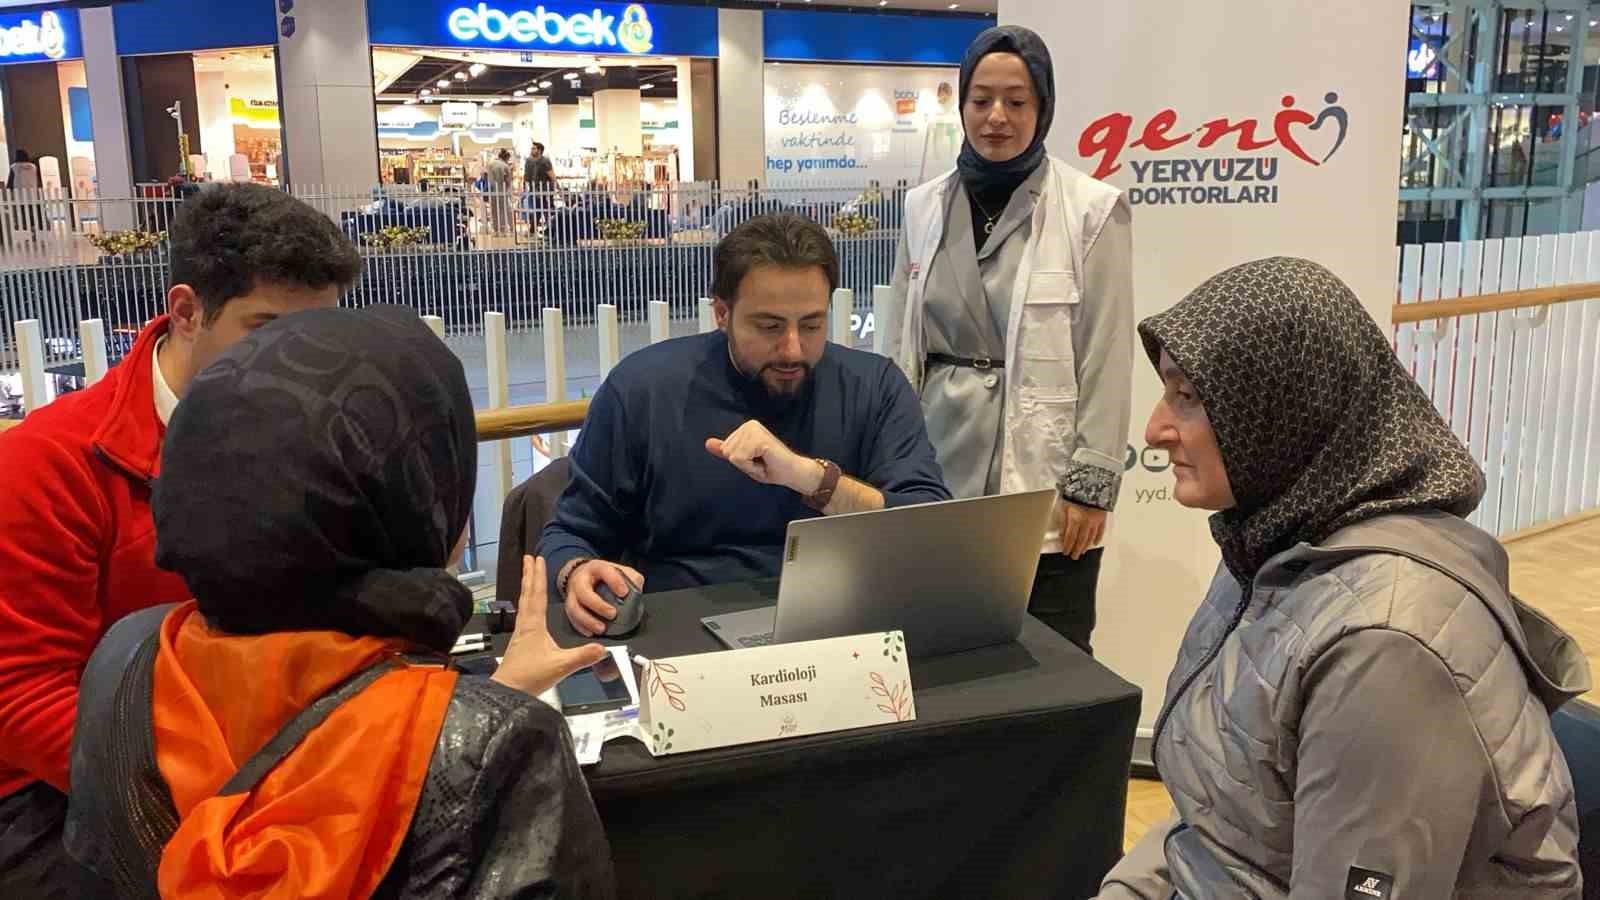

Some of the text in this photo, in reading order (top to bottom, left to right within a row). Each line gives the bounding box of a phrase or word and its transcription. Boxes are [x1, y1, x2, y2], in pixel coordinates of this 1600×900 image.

[448, 2, 617, 46] ebebek
[778, 109, 857, 126] Beslenme
[781, 132, 855, 149] vaktinde
[766, 156, 792, 172] hep
[1129, 157, 1278, 183] YERYÜZÜ
[1128, 185, 1278, 205] DOKTORLARI
[750, 665, 816, 686] Kardioloji
[760, 692, 807, 707] Masası
